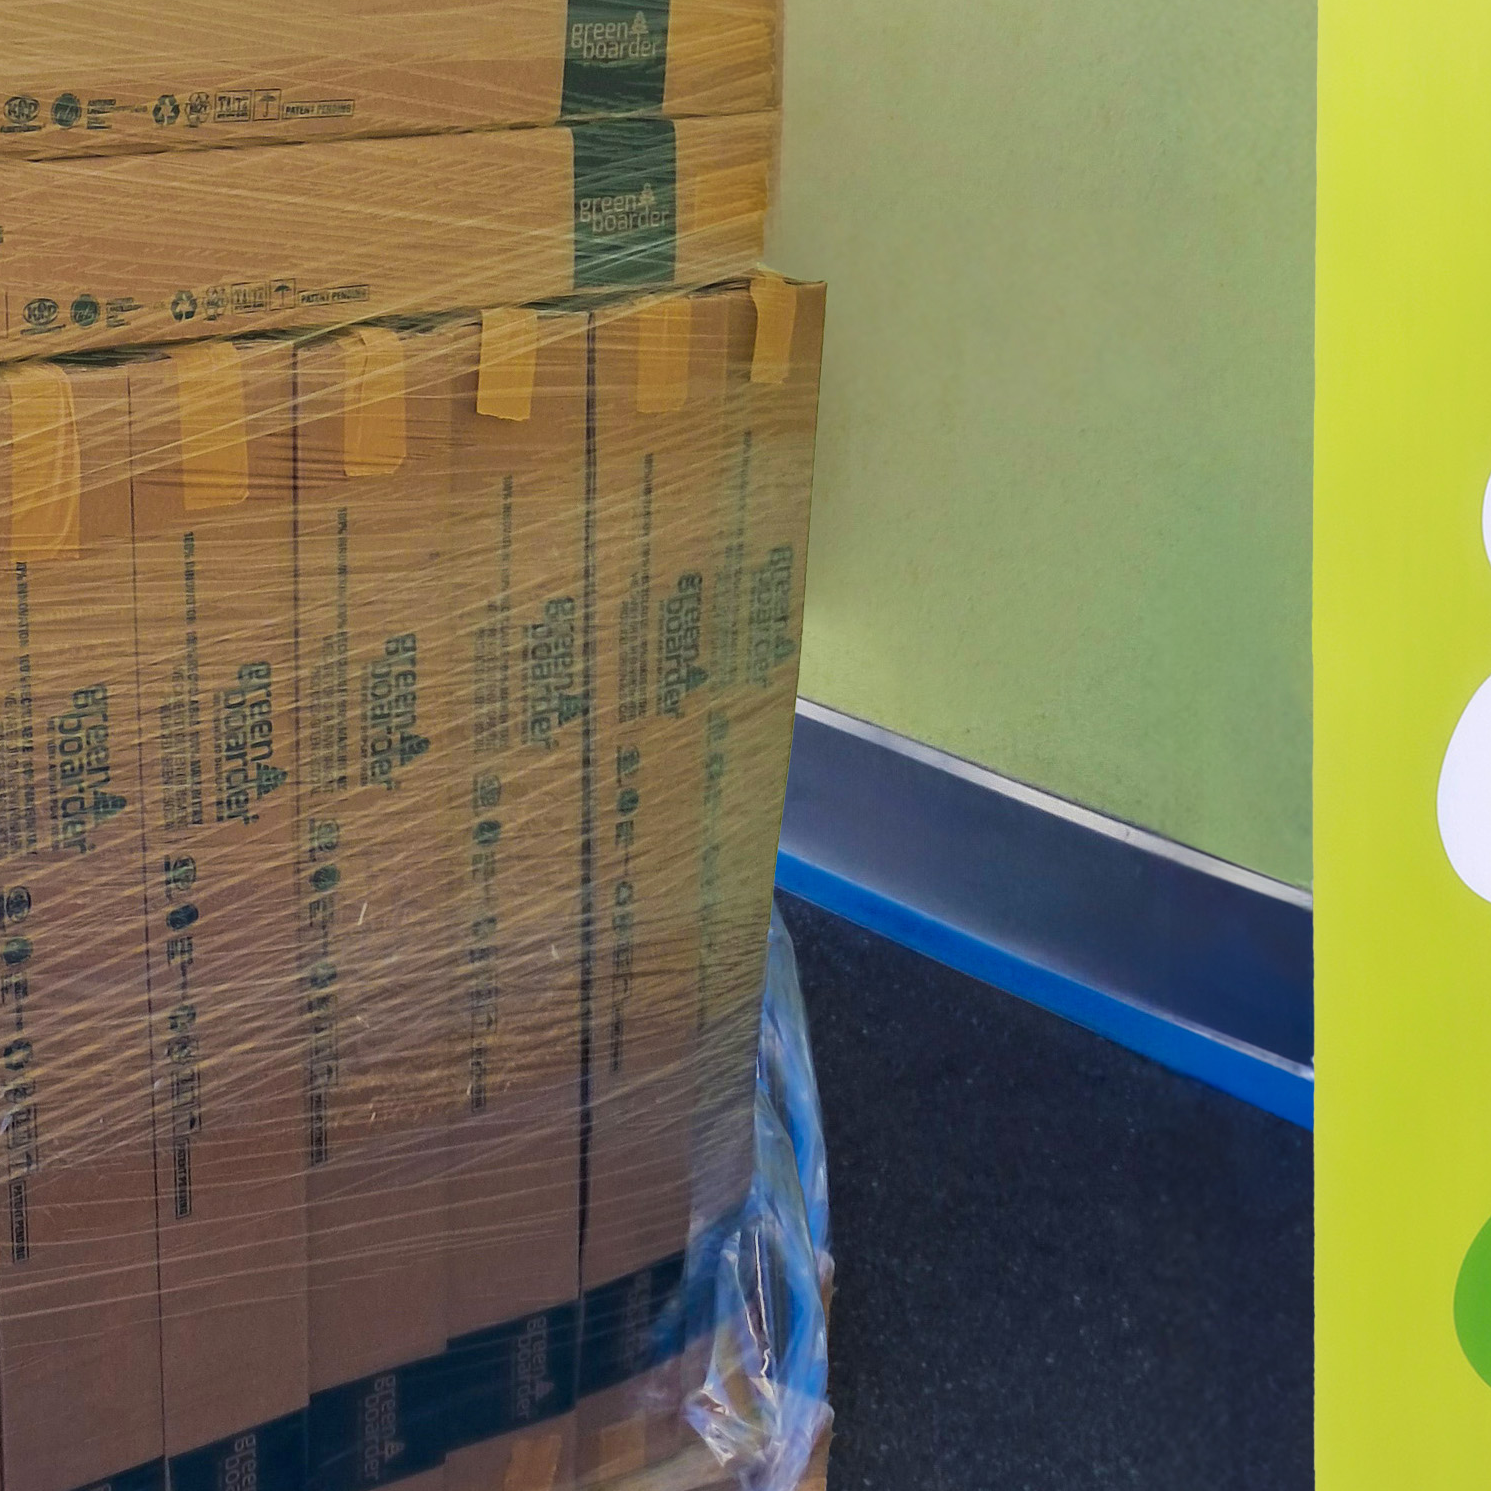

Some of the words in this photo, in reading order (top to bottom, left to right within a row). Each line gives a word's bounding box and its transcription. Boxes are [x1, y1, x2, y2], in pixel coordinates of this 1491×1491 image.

[571, 22, 628, 48] green
[583, 39, 658, 59] boarder
[580, 195, 636, 222] green
[593, 209, 669, 232] boarder
[72, 686, 111, 789] green
[58, 714, 90, 854] boarder
[374, 1374, 396, 1439] green
[364, 1395, 380, 1480] boarder
